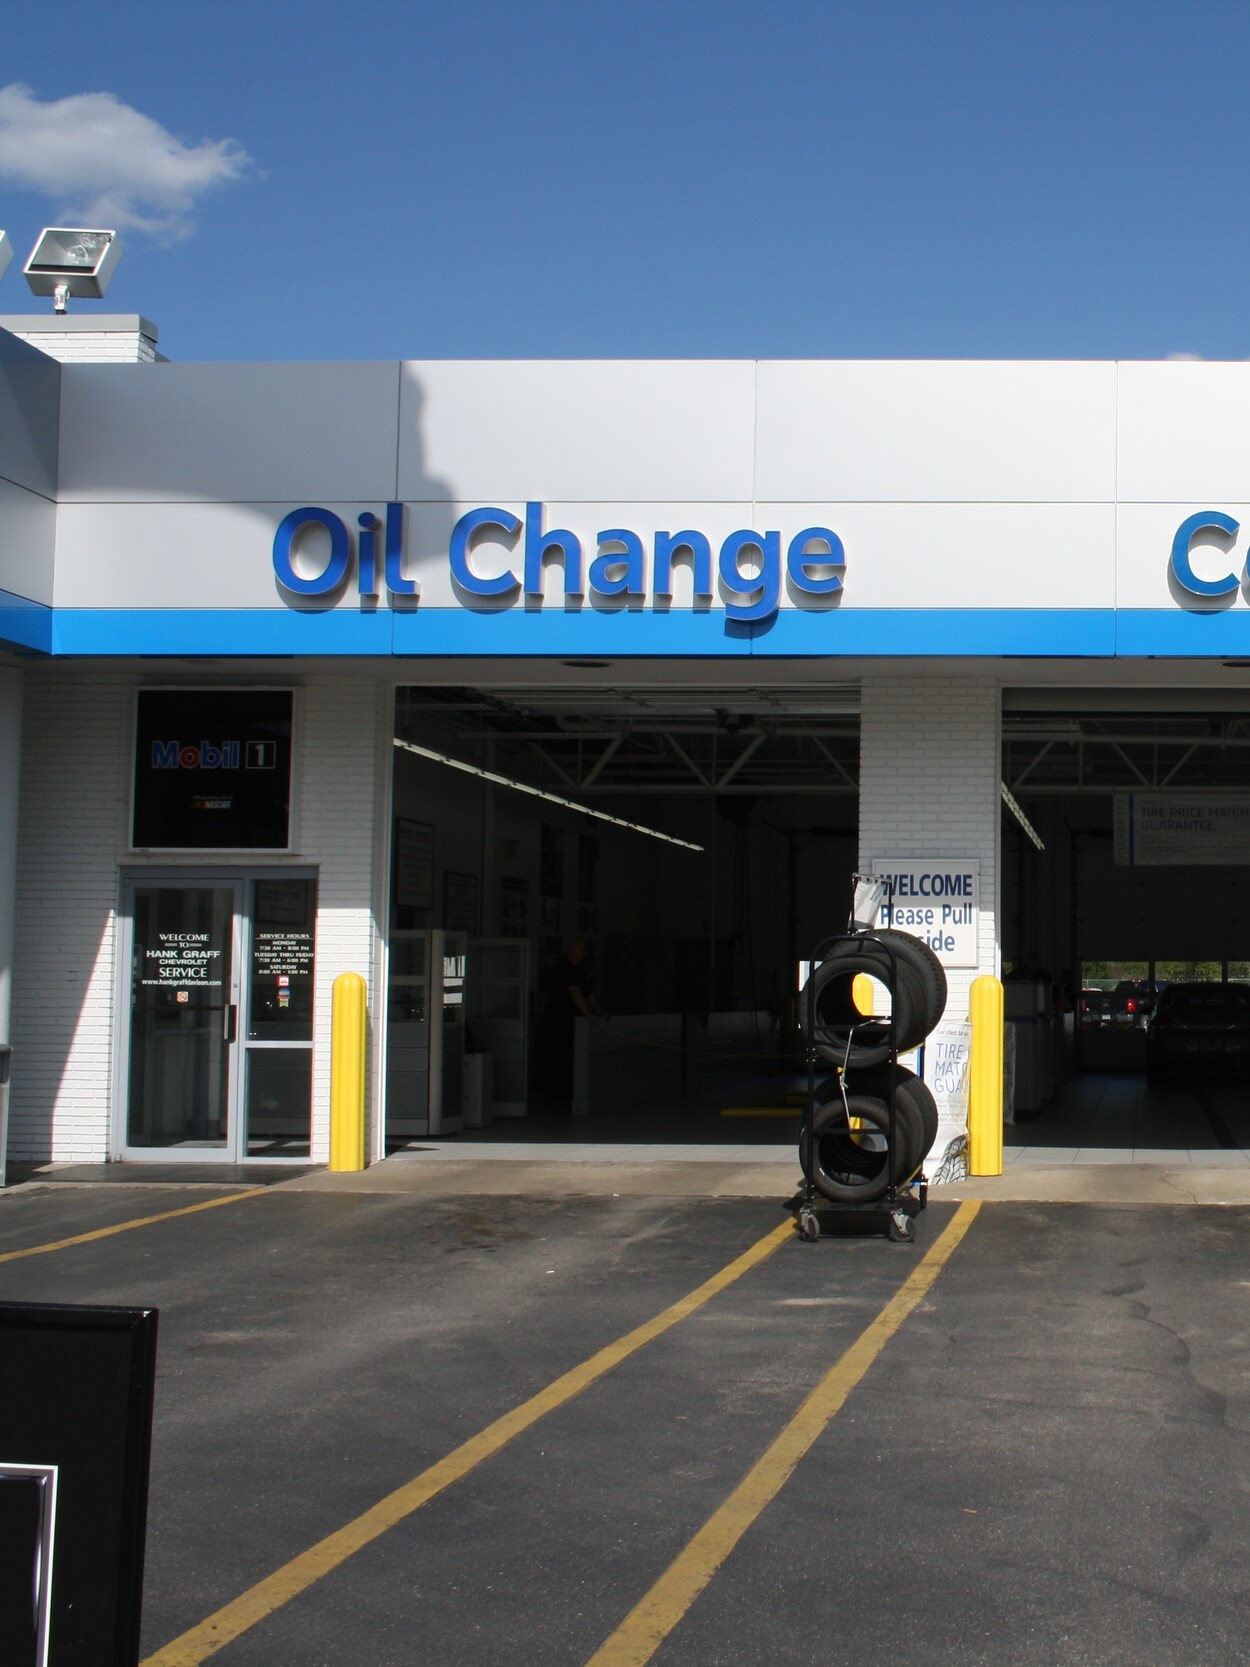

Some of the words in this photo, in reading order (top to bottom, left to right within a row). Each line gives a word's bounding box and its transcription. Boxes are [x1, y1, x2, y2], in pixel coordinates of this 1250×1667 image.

[272, 502, 420, 597] Oil
[448, 502, 846, 621] Change
[151, 740, 241, 769] Mobil
[255, 743, 265, 766] 1
[203, 800, 232, 809] NASCAR
[1141, 807, 1166, 818] TIRE
[1170, 807, 1204, 818] PRICE
[1208, 807, 1249, 818] MATCH
[1141, 820, 1217, 832] GUARANTEE.
[880, 874, 973, 896] WELCOME
[880, 903, 934, 925] Please
[942, 902, 973, 925] Pull
[159, 933, 210, 942] WELCOME
[146, 950, 179, 958] HANK
[182, 950, 221, 958] GRAFF
[159, 967, 208, 978] SERVICE
[936, 1043, 964, 1060] TIRE
